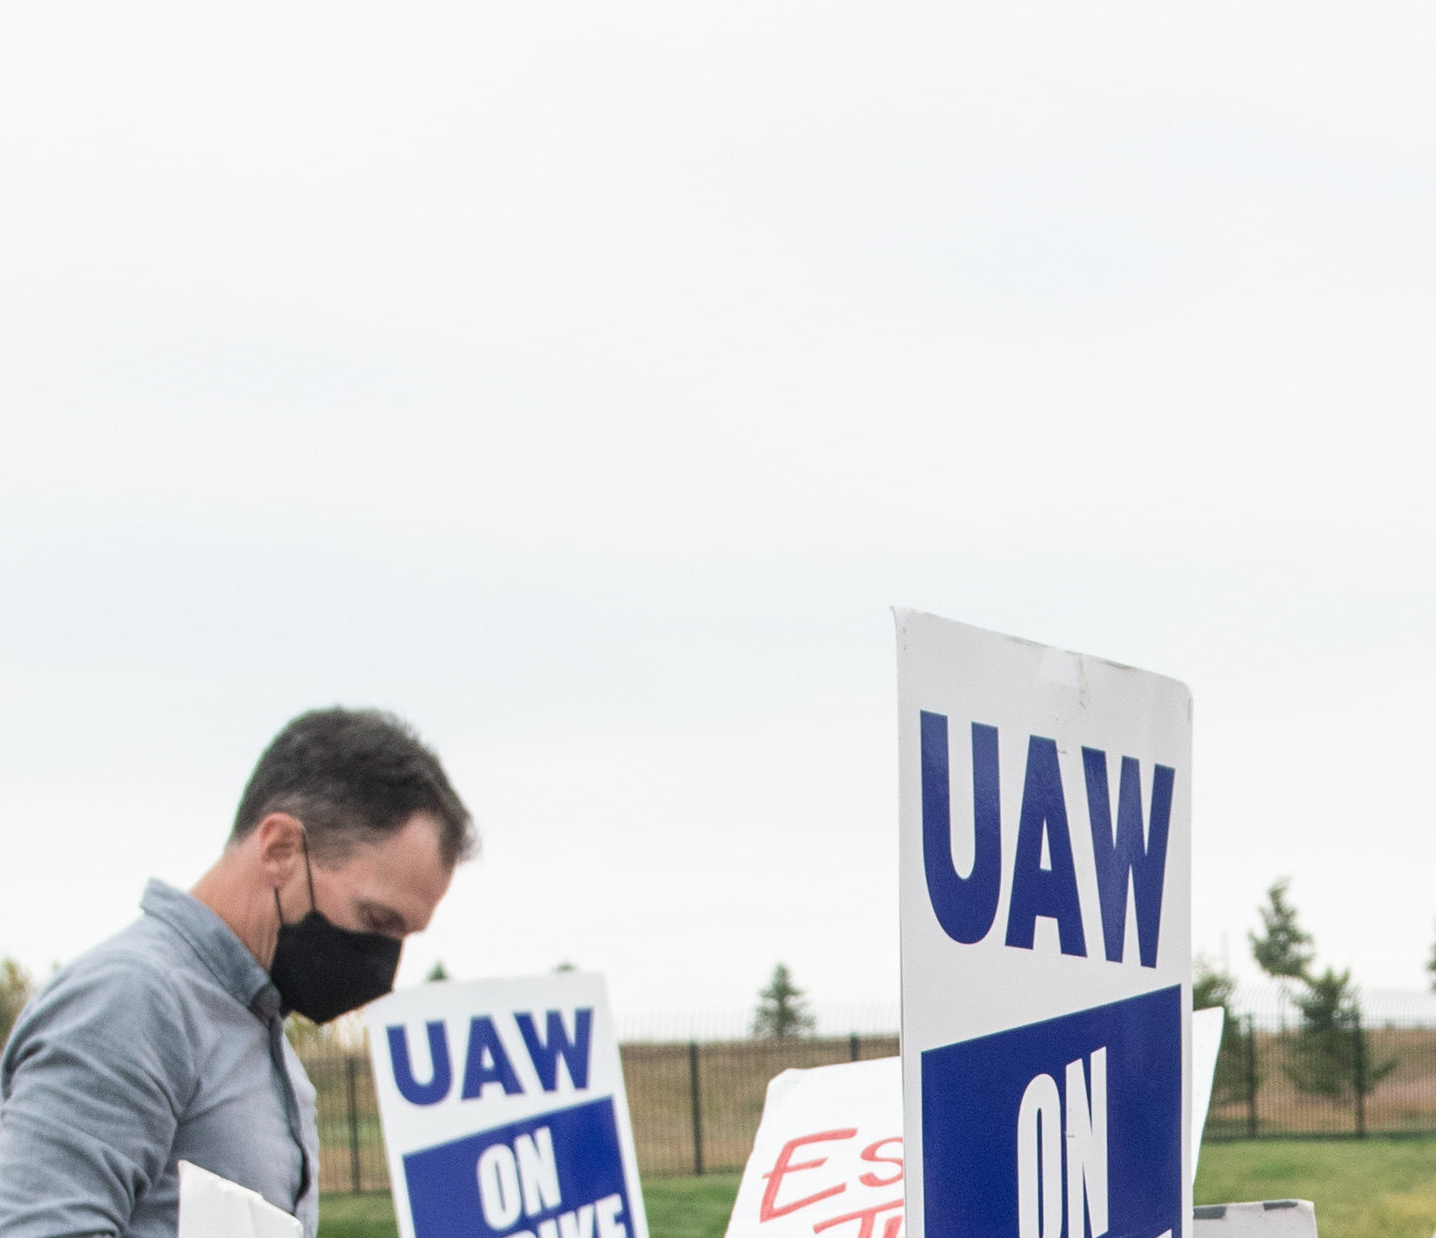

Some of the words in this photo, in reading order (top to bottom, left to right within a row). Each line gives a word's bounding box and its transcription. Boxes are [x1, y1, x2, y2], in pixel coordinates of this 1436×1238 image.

[920, 710, 1176, 968] UAW
[386, 1008, 594, 1107] UAW
[477, 1128, 561, 1232] ON
